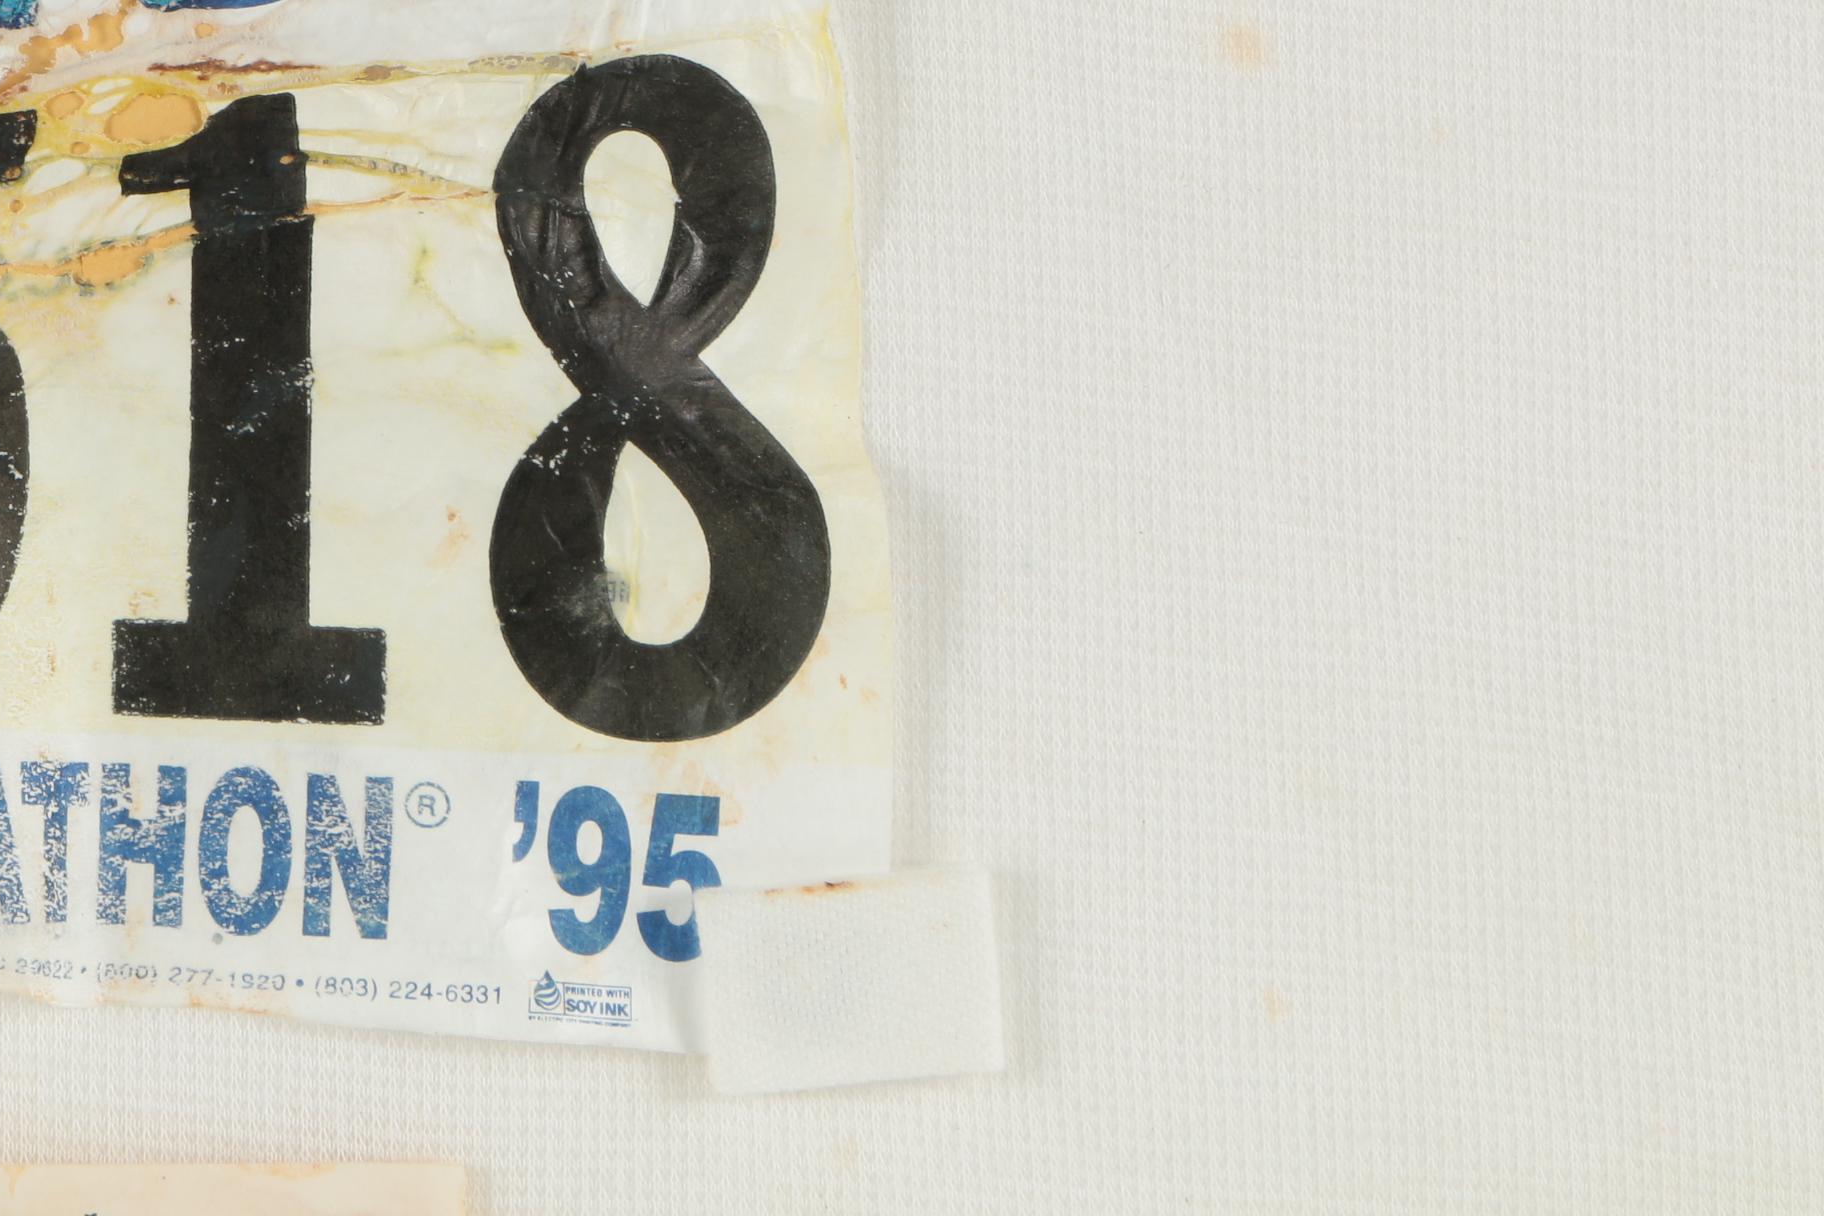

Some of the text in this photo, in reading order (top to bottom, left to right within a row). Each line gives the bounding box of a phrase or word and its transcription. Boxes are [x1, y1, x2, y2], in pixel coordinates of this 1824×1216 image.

[314, 974, 379, 1002] (803)
[388, 981, 504, 1006] 224-6331
[565, 985, 630, 999] PRINTED WITH
[565, 998, 629, 1017] SOY INK
